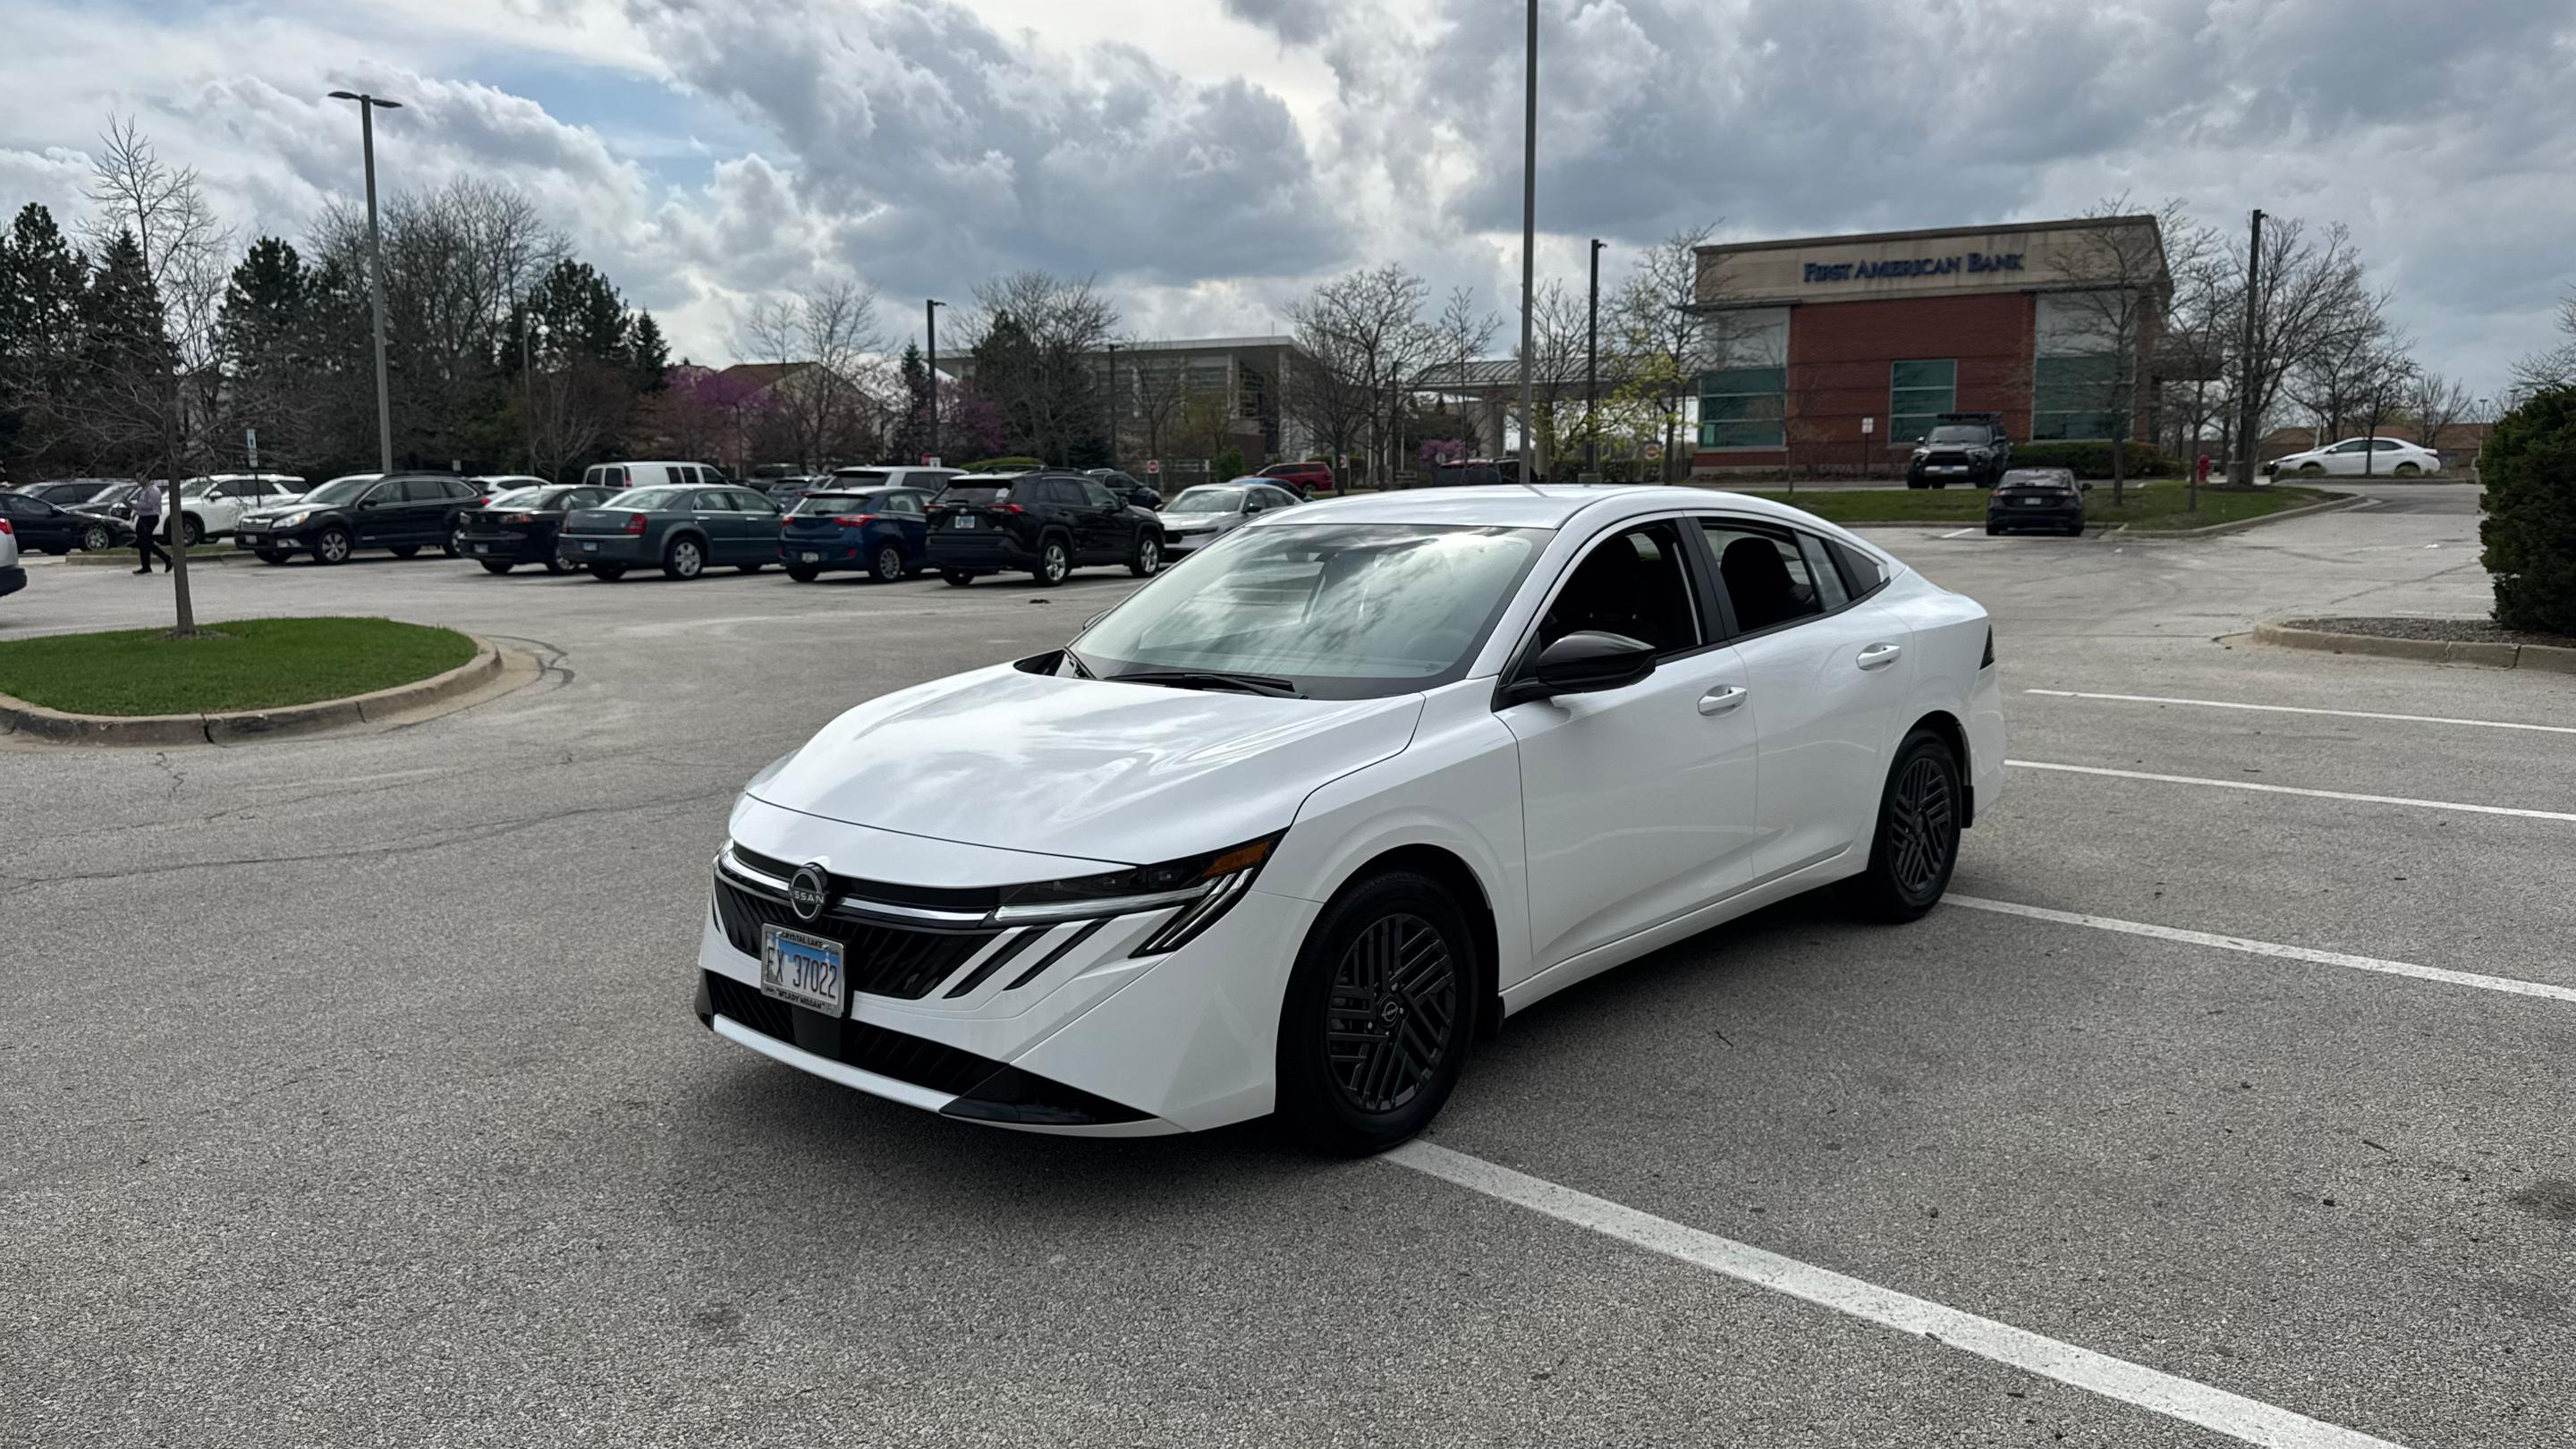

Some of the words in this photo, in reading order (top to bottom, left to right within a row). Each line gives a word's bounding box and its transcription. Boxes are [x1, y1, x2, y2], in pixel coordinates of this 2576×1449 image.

[1803, 262, 1853, 283] FIRST
[1854, 257, 1962, 279] AMERICAN
[1967, 252, 2025, 273] BANK
[793, 889, 824, 903] SSAN
[792, 953, 837, 999] 37022
